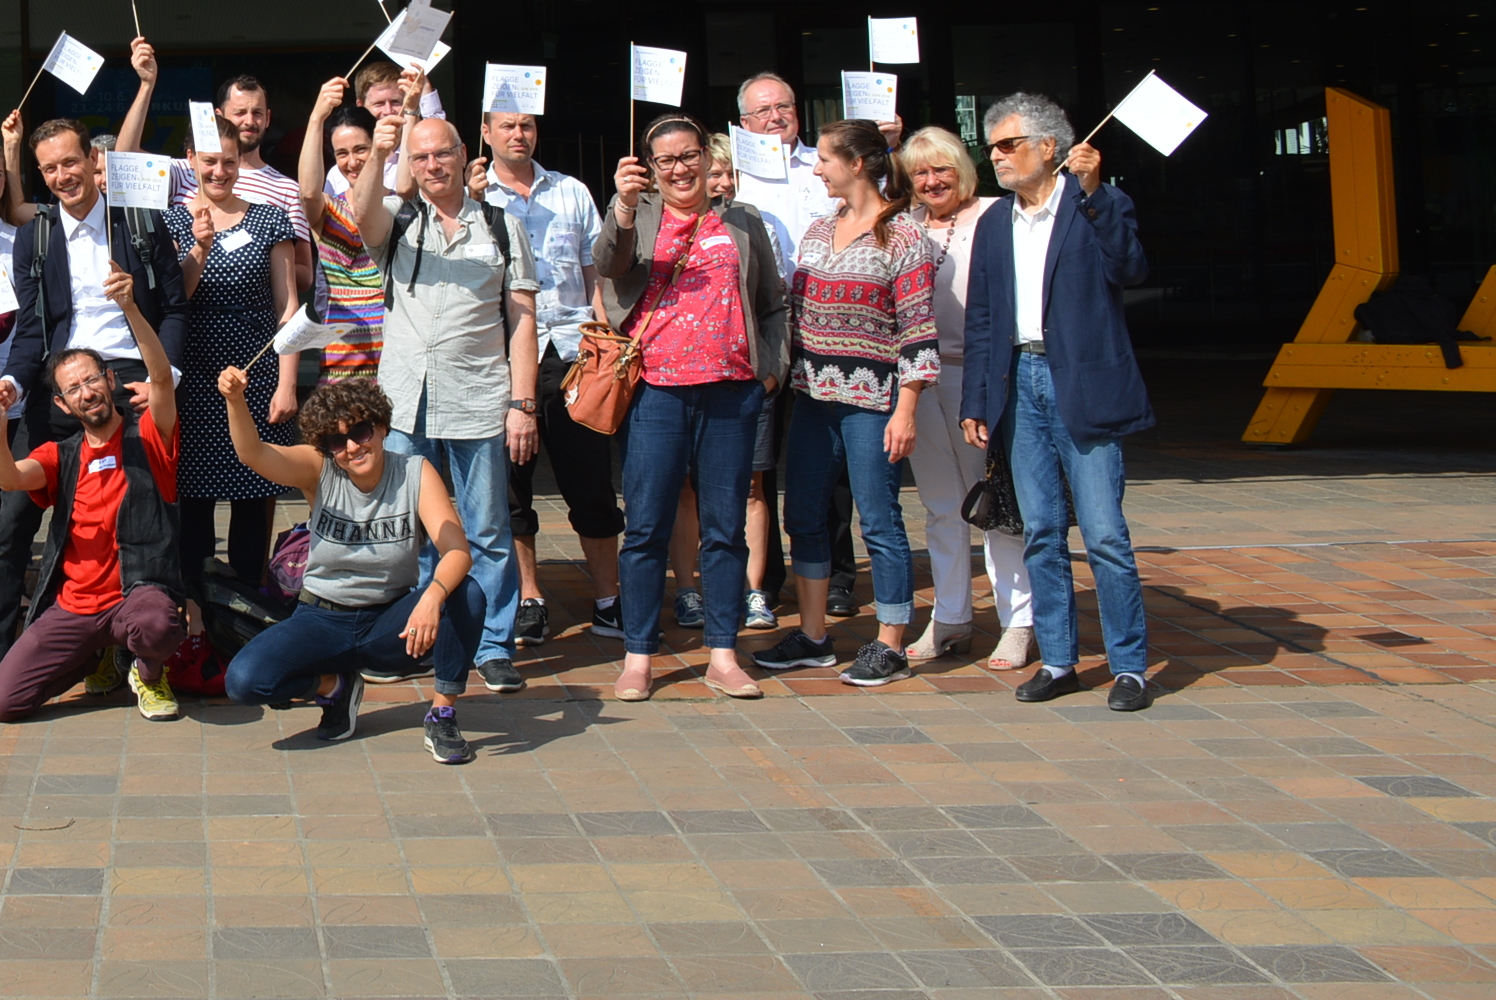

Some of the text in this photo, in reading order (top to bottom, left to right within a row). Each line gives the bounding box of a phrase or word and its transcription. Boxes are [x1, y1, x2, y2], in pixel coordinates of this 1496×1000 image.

[647, 77, 678, 87] VIELF
[491, 83, 517, 91] ZEIGEN
[110, 164, 140, 172] FLAGGE
[110, 173, 137, 181] ZEIGEN
[125, 181, 162, 192] VIELFALT
[316, 513, 412, 541] RIHANNA
